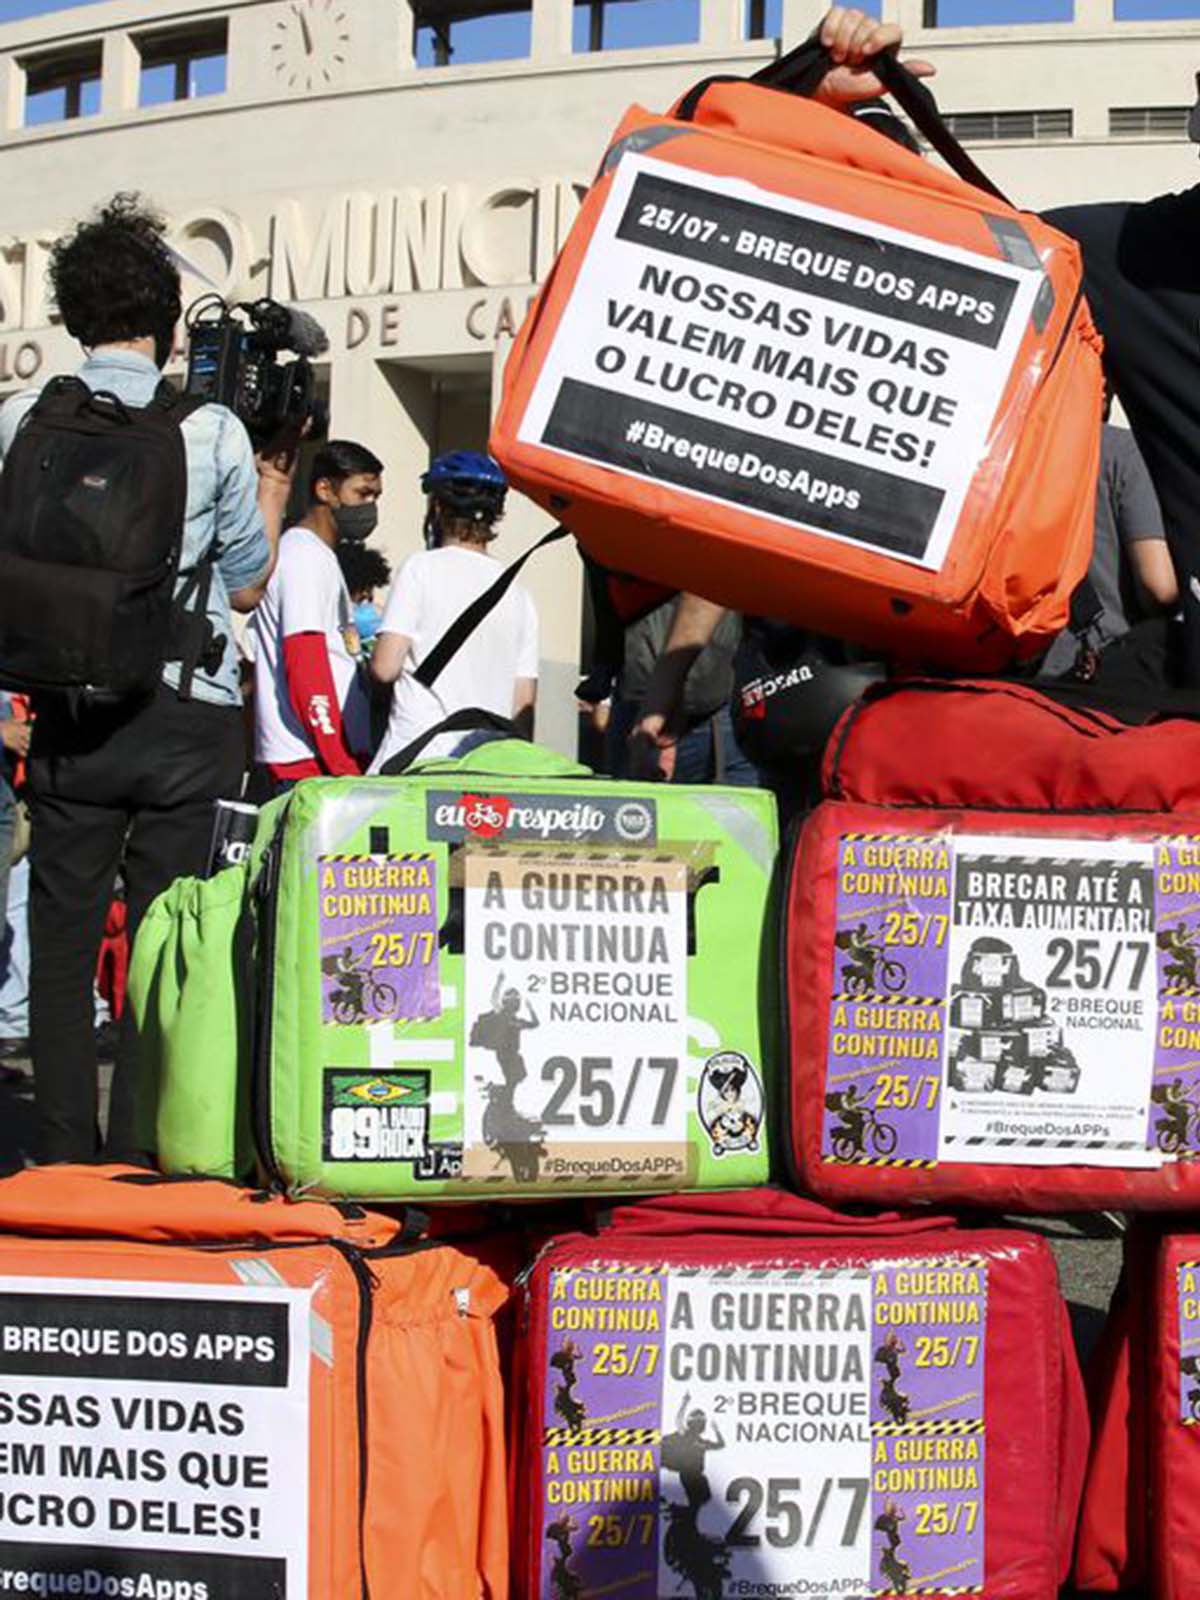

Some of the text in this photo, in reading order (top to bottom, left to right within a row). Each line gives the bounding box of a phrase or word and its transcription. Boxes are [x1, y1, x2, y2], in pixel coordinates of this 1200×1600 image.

[638, 204, 718, 244] 25/07
[735, 230, 851, 283] BREQUE
[854, 265, 914, 301] DOS
[917, 286, 997, 324] APPS
[346, 304, 399, 349] DE
[638, 264, 950, 377] NOSSAS VIDAS
[607, 299, 958, 427] VALEM MAIS QUE
[595, 345, 936, 468] O LUCRO DELES!
[626, 420, 861, 510] #BrequeDosApps
[435, 806, 466, 827] eu
[505, 803, 606, 838] respeito
[843, 845, 949, 870] A GUERRA
[1158, 848, 1170, 865] A
[322, 866, 432, 889] A GUERRA
[483, 871, 669, 914] A GUERRA
[842, 872, 948, 897] CONTINUA
[968, 870, 1143, 903] BRECAR ATÉ A
[323, 893, 431, 917] CONTINUA
[958, 901, 1015, 928] TAXA
[1022, 901, 1151, 933] AUMENTAR!
[483, 922, 669, 963] CONTINUA
[884, 911, 949, 946] 25/7
[372, 932, 434, 967] 25/7
[1046, 937, 1151, 991] 25/7
[551, 972, 674, 997] BREQUE
[550, 1001, 678, 1024] NACIONAL
[834, 1006, 942, 1031] A GUERRA
[1067, 998, 1143, 1014] BREQUE
[1162, 1000, 1175, 1020] A
[1066, 1016, 1142, 1030] NACIONAL
[832, 1034, 939, 1058] CONTINUA
[540, 1056, 679, 1127] 25/7
[875, 1074, 940, 1109] 25/7
[331, 1107, 379, 1158] 89
[379, 1128, 425, 1158] ROCK
[544, 1149, 683, 1176] #BrequeDosAPPs
[553, 1277, 661, 1301] A GUERRA
[876, 1271, 980, 1295] A GUERRA
[1183, 1273, 1196, 1292] A
[552, 1306, 660, 1331] CONTINUA
[670, 1292, 866, 1332] A GUERRA
[875, 1301, 980, 1325] CONTINUA
[3, 1326, 275, 1363] BREQUE DOS APPS
[592, 1344, 660, 1376] 25/7
[915, 1336, 979, 1368] 25/7
[670, 1343, 864, 1382] CONTINUA
[111, 1397, 245, 1437] VIDAS
[738, 1392, 866, 1416] BREQUE
[736, 1422, 869, 1443] NACIONAL
[547, 1450, 653, 1474] A GUERRA
[875, 1438, 979, 1463] A GUERRA
[59, 1445, 269, 1490] MAIS QUE
[875, 1466, 979, 1492] CONTINUA
[547, 1478, 653, 1503] CONTINUA
[109, 1498, 261, 1540] DELES!
[725, 1477, 869, 1548] 25/7
[916, 1501, 978, 1535] 25/7
[587, 1514, 653, 1547] 25/7
